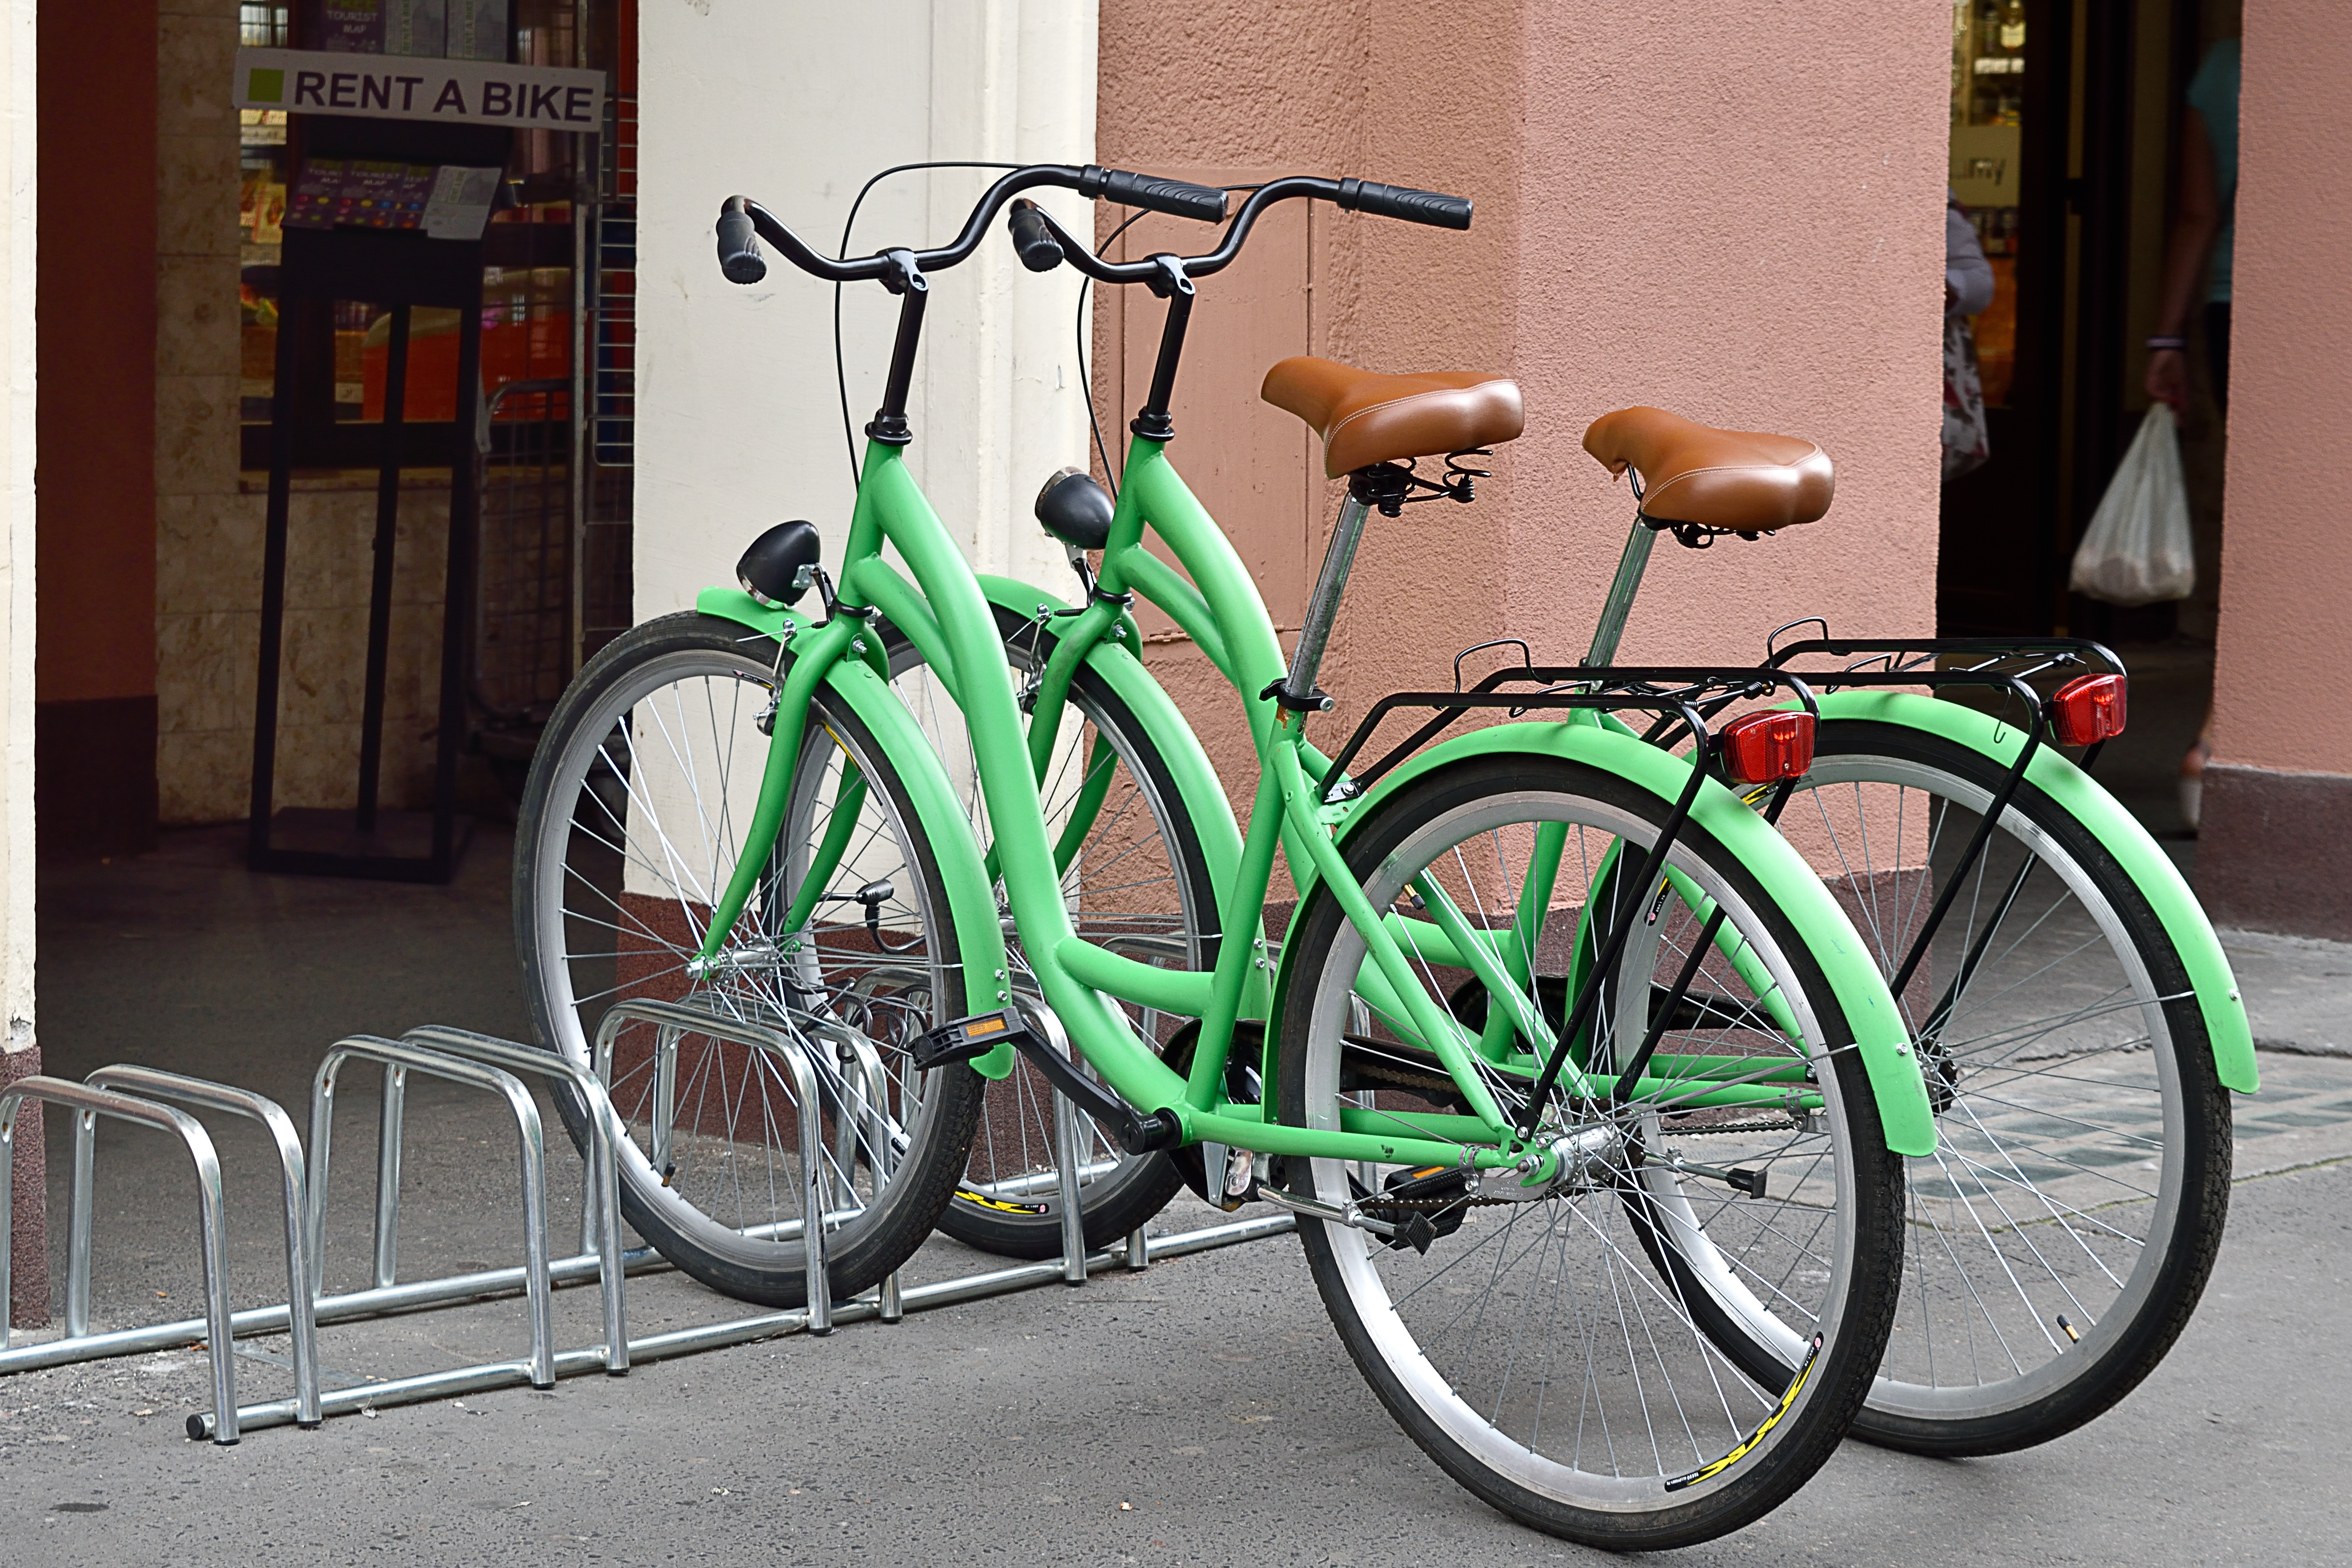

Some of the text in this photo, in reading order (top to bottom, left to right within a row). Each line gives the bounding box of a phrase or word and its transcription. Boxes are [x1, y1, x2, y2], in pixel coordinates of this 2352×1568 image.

[326, 10, 378, 22] TOURIST
[343, 24, 366, 34] MAP
[295, 71, 594, 123] RENT A BIKE
